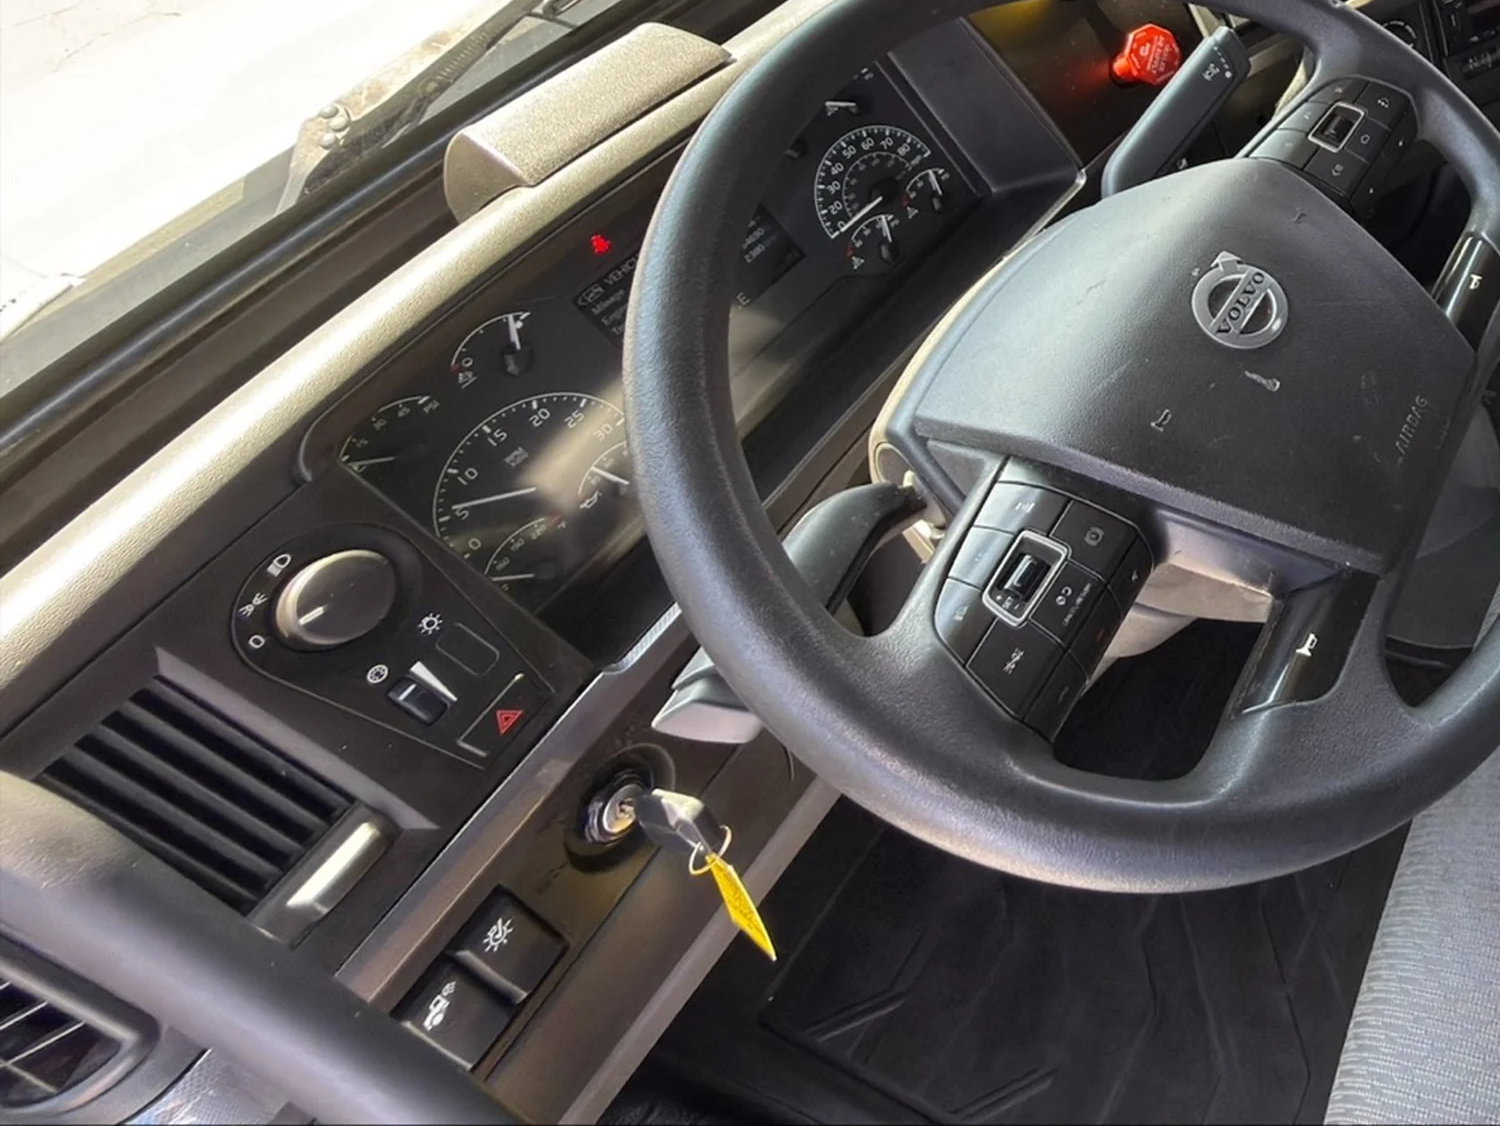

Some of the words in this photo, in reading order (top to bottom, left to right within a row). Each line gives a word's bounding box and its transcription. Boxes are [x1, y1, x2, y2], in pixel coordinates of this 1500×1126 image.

[861, 137, 875, 151] 60
[879, 137, 894, 149] 70
[897, 143, 911, 156] 80
[842, 145, 857, 159] 50
[830, 163, 844, 175] 40
[826, 180, 841, 195] 30
[828, 200, 843, 215] 20
[736, 292, 751, 305] E
[1216, 272, 1265, 333] VOLVO
[528, 407, 551, 427] 20
[564, 409, 585, 429] 25
[1395, 394, 1428, 455] AIRBAG
[487, 428, 508, 447] 15
[593, 424, 613, 442] 30
[457, 467, 479, 486] 10
[454, 507, 470, 520] 5
[468, 537, 482, 550] 0
